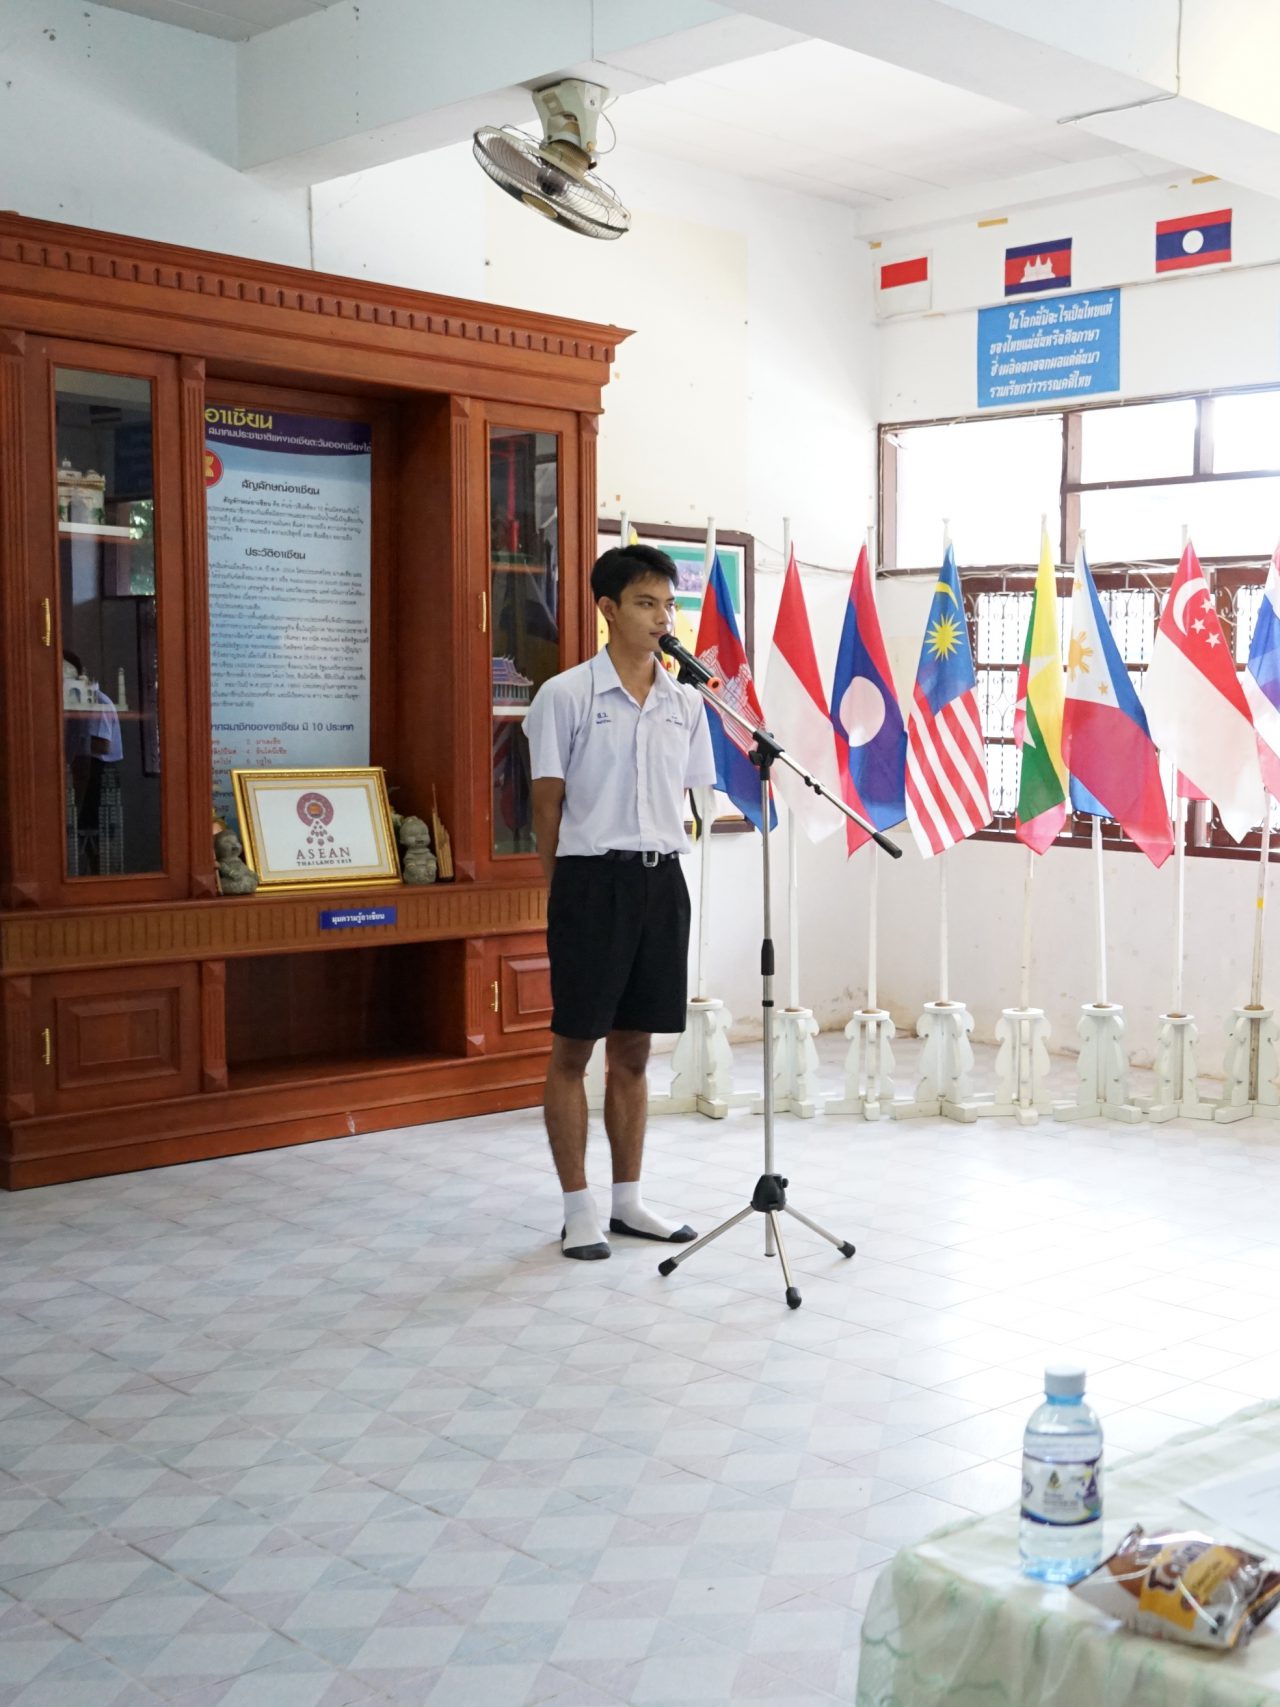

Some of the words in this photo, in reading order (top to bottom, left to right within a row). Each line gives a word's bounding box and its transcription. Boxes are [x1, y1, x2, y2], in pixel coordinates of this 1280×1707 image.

[205, 407, 273, 430] อาเซียน
[241, 478, 320, 496] สัญลักษณ์อาเซียน
[245, 547, 306, 560] ประวัติอาเซียน
[312, 723, 324, 732] 10
[296, 846, 350, 860] ASEAN
